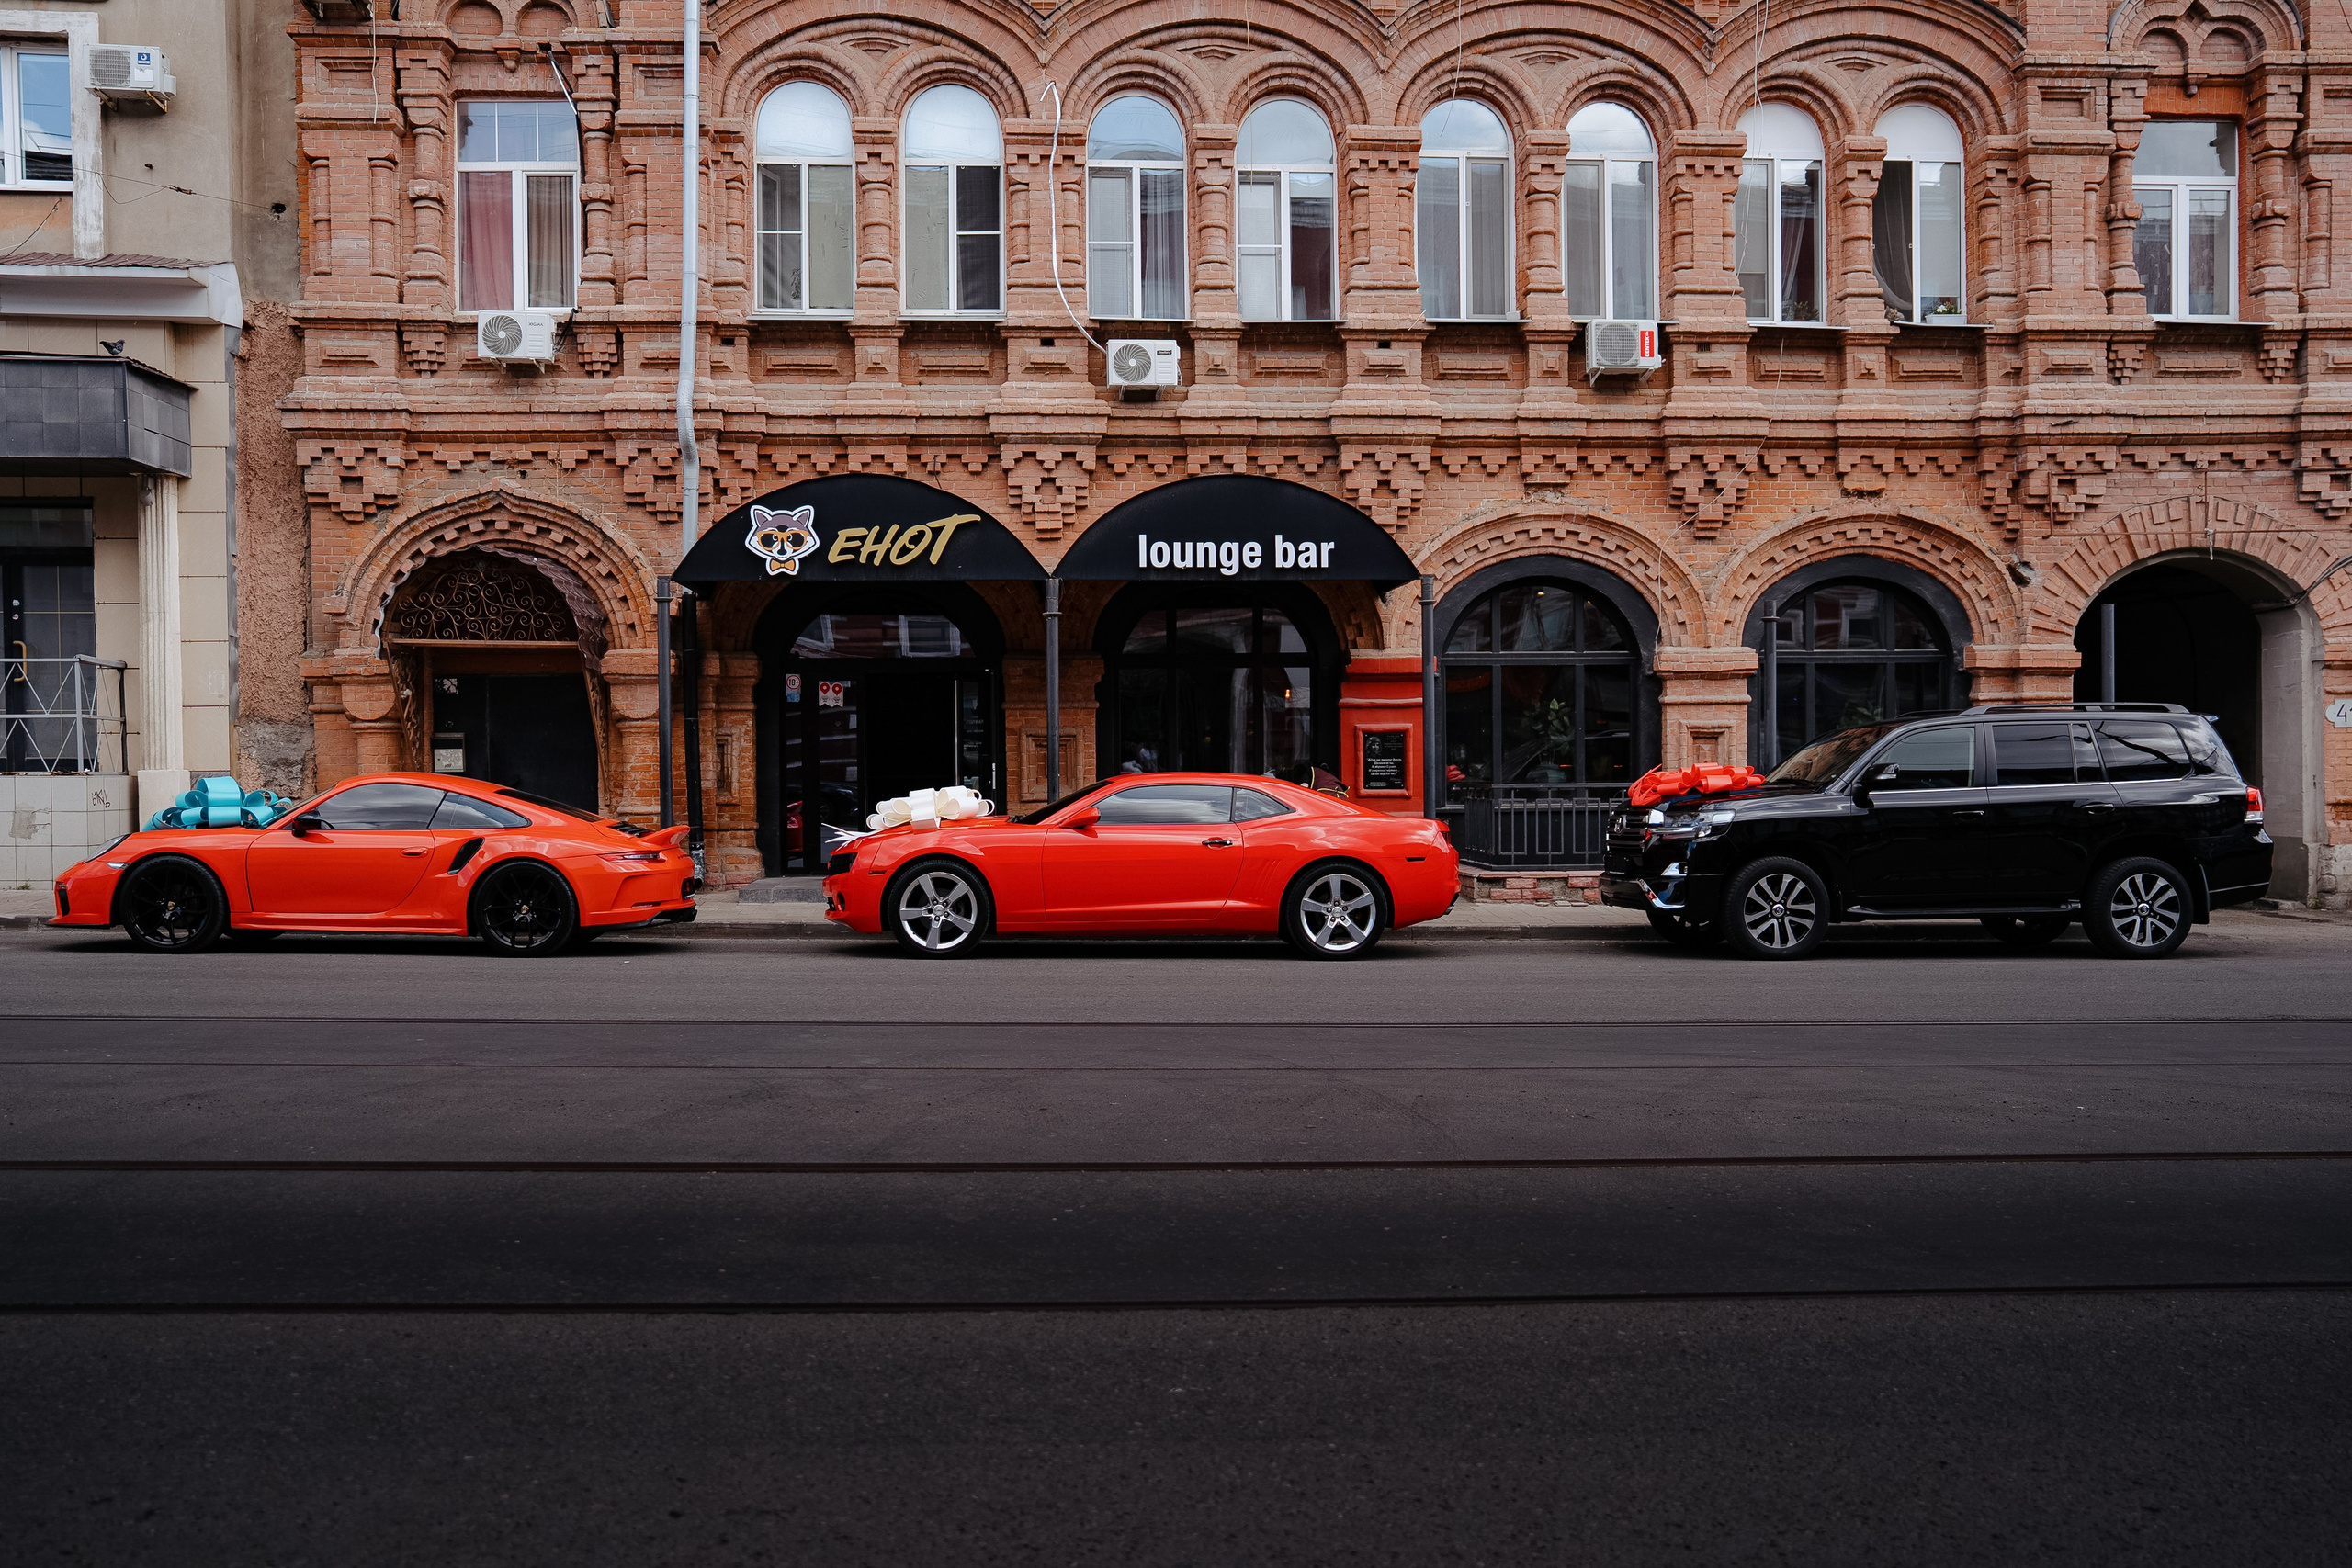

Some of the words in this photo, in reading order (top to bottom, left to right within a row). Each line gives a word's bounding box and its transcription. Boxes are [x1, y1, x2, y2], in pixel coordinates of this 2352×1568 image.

[827, 513, 981, 567] ЕНОТ
[1138, 534, 1262, 576] lounge
[1275, 534, 1335, 568] bar
[788, 678, 799, 686] 18+
